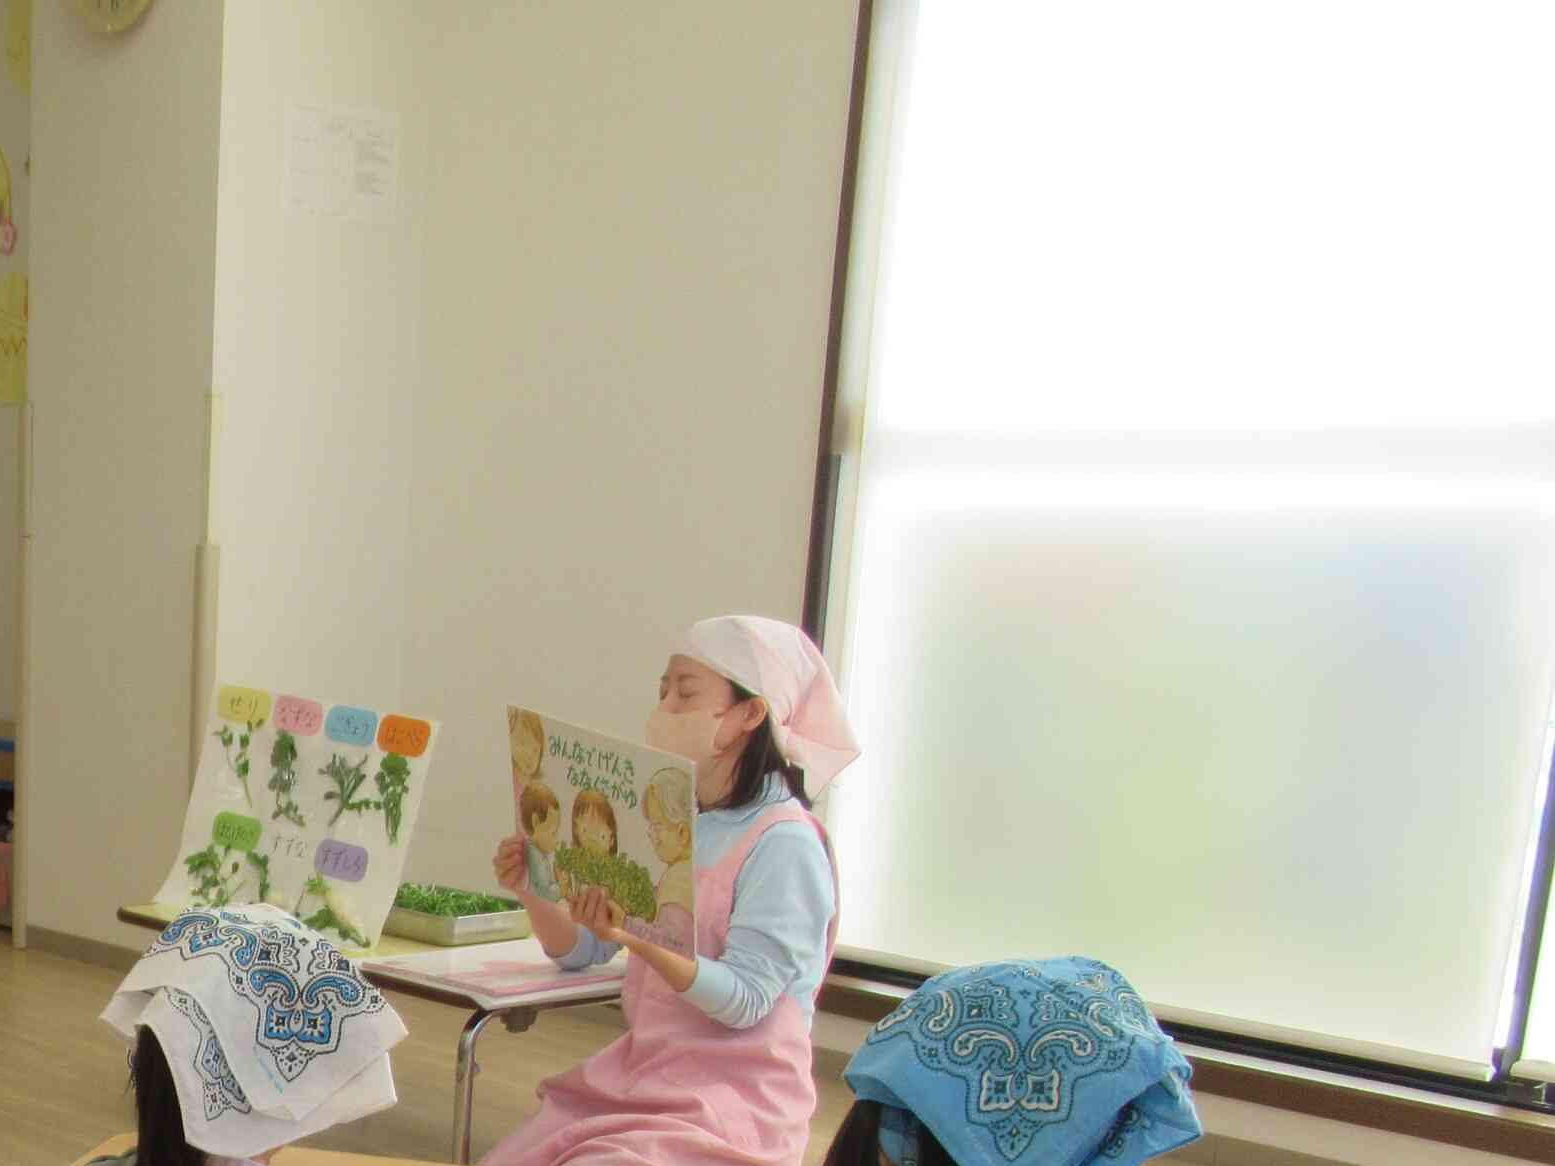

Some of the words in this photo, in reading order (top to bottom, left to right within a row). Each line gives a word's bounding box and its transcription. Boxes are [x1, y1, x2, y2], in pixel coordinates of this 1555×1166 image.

[228, 695, 259, 717] せり
[565, 764, 638, 810] ななくさがゆ
[321, 847, 362, 875] すずしろ
